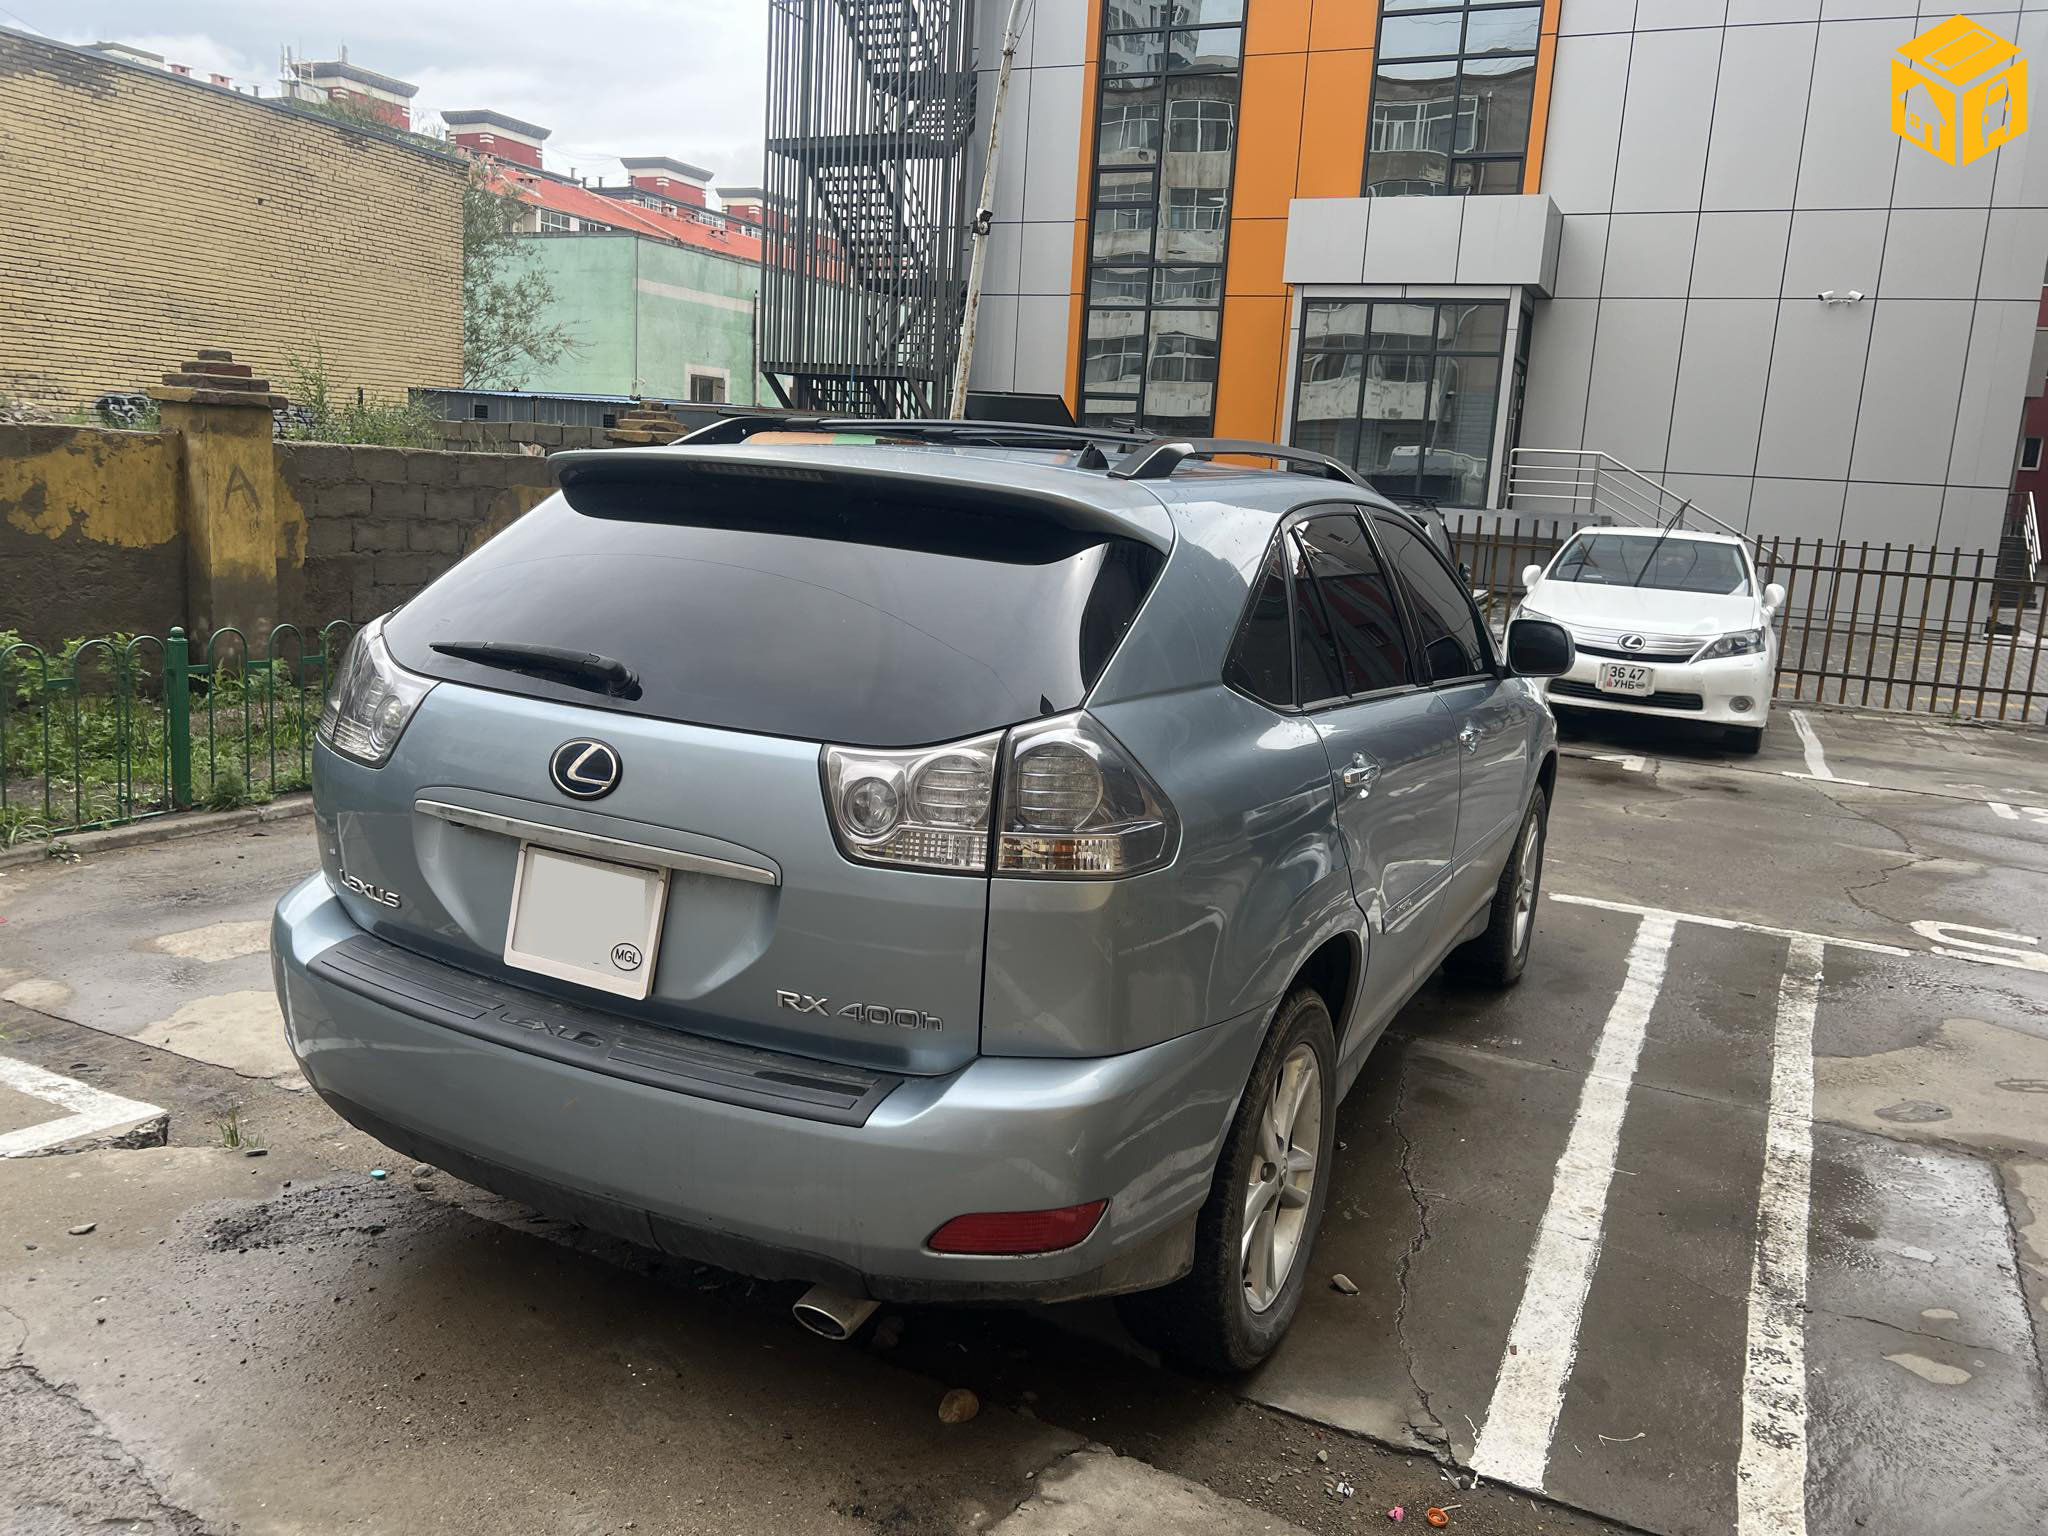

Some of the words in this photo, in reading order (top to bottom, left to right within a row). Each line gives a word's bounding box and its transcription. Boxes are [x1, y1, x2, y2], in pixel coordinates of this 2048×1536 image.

[1609, 666, 1626, 679] 36
[1629, 668, 1645, 681] 47
[1613, 679, 1635, 690] УНБ
[338, 868, 401, 908] LEXUS
[615, 948, 638, 965] MGL
[776, 988, 830, 1018] RX
[836, 1001, 943, 1033] 400h
[499, 1011, 606, 1049] LEXUS
